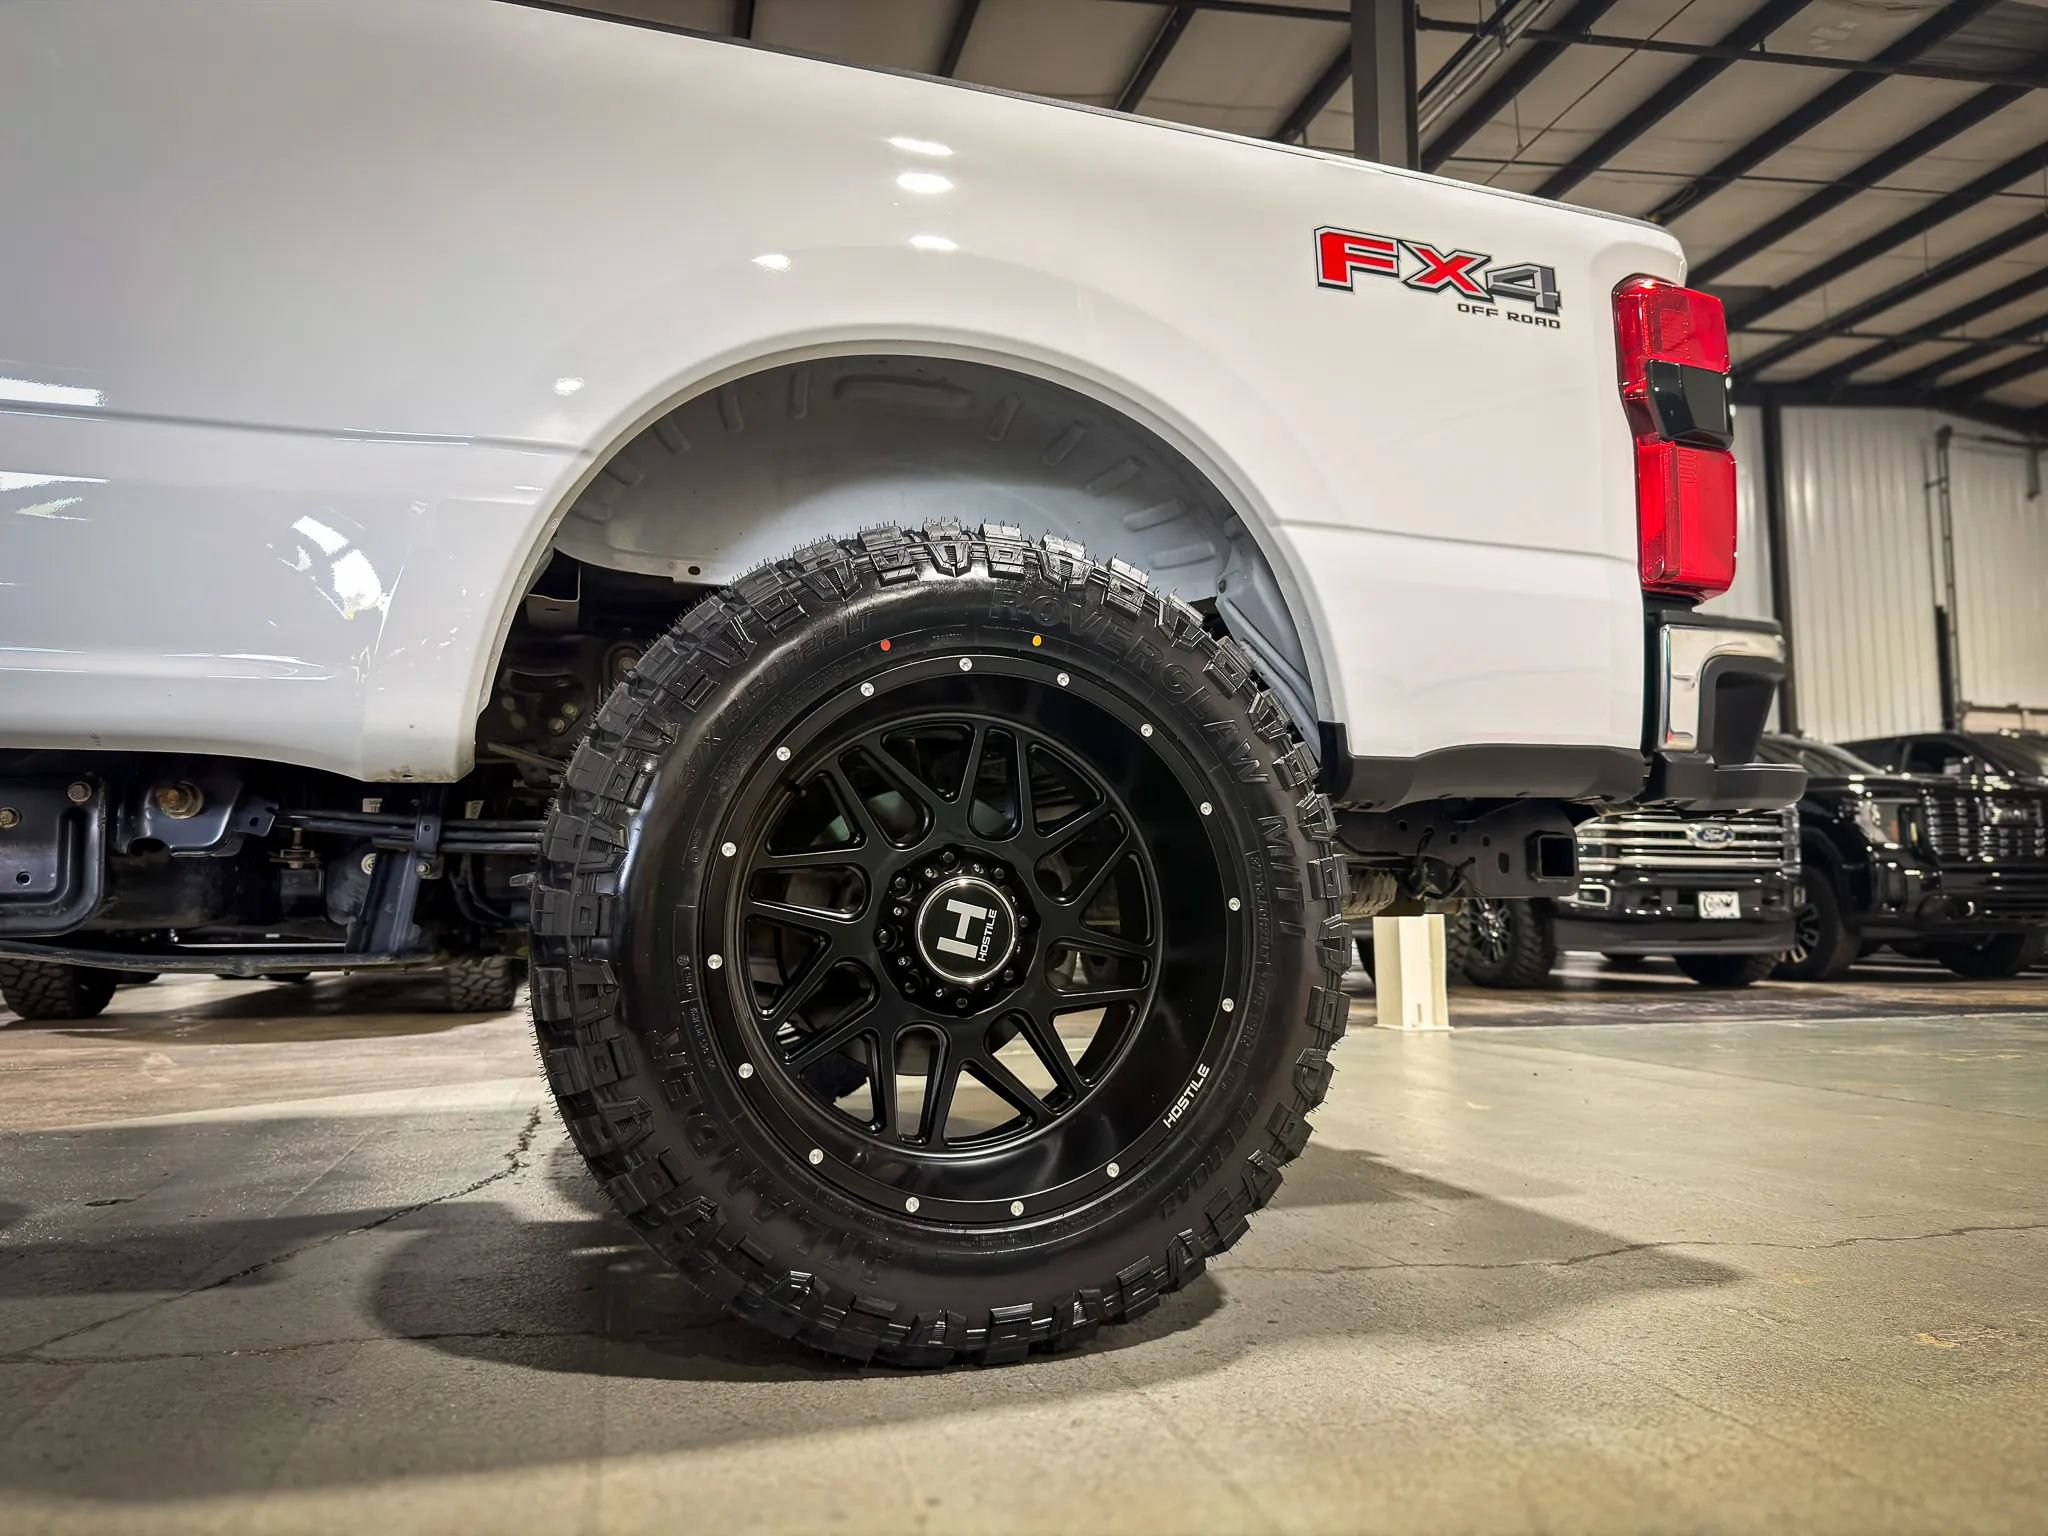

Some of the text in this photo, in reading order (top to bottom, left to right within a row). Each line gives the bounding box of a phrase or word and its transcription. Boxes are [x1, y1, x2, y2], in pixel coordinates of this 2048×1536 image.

[1313, 225, 1561, 316] FX4
[1457, 303, 1561, 330] OFF ROAD
[989, 584, 1271, 788] ROVERCLAW
[976, 908, 998, 963] HOSTILE
[1162, 1062, 1211, 1129] HOSTILE
